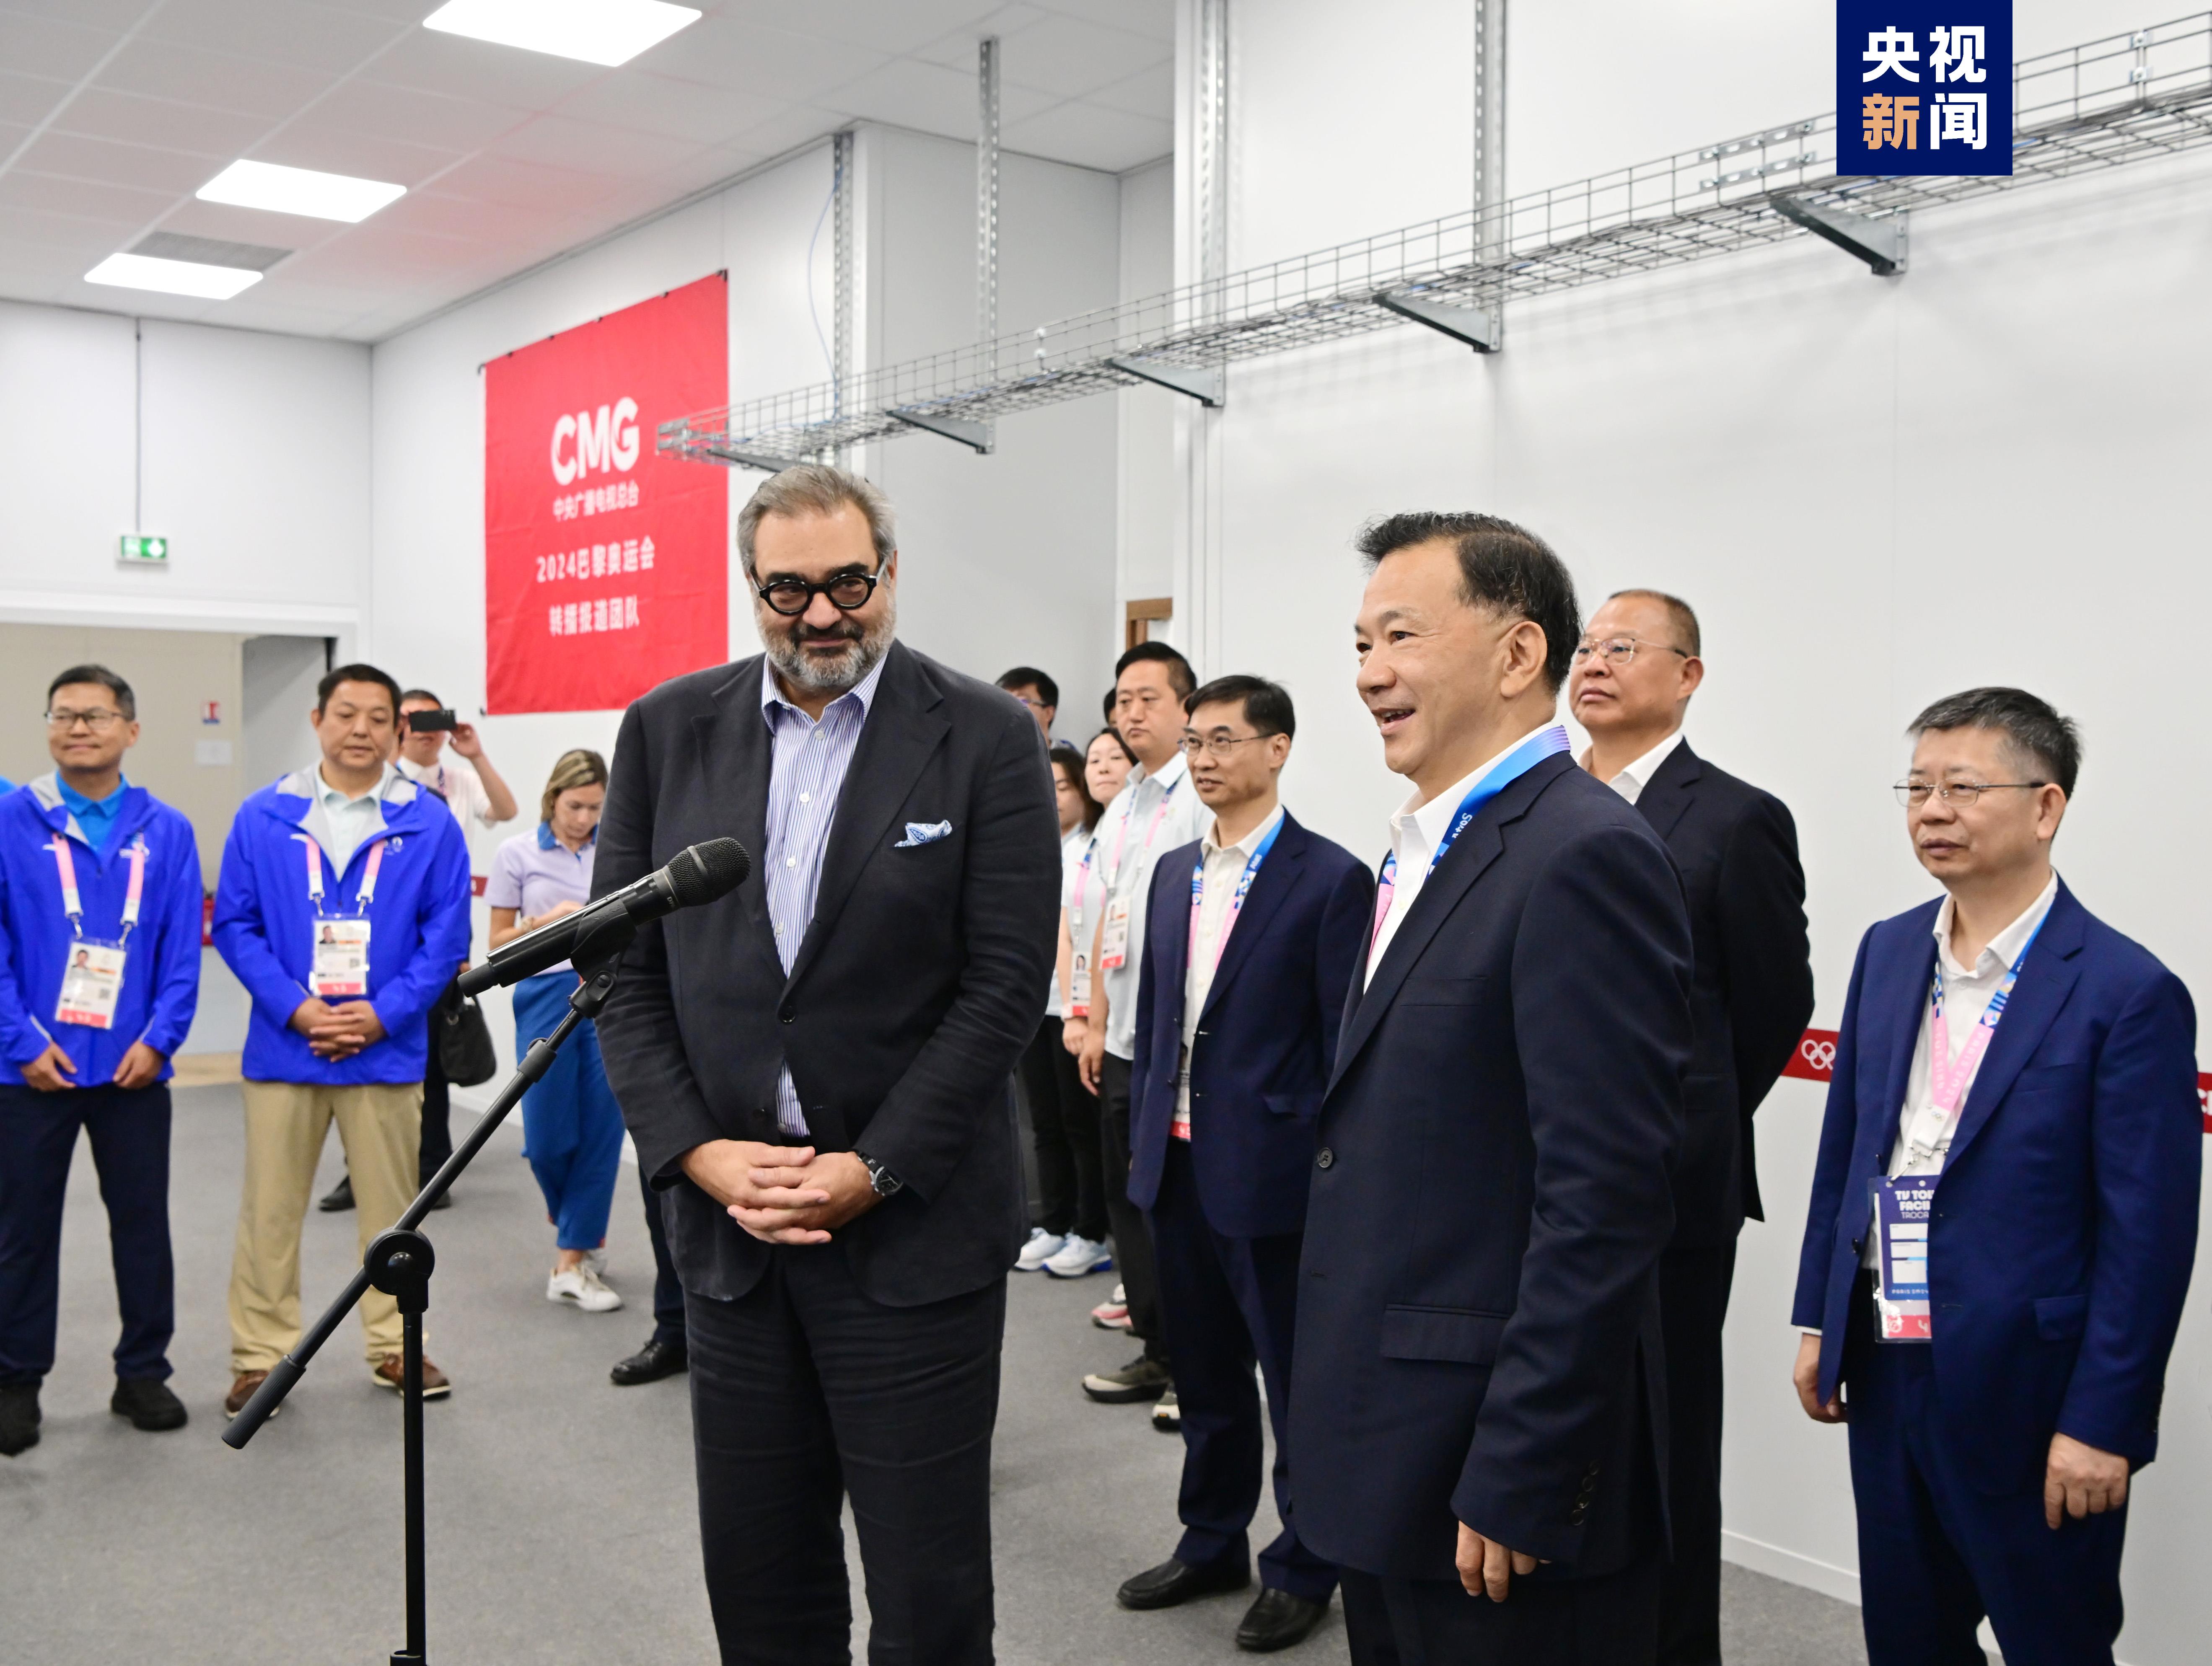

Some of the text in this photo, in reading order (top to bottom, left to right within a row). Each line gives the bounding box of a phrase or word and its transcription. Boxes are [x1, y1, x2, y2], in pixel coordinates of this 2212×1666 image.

[550, 396, 640, 486] CMG
[553, 479, 640, 522] 中央广播电视总台
[536, 535, 655, 583] 2024巴黎奥运会
[549, 595, 640, 637] 转播报道团队
